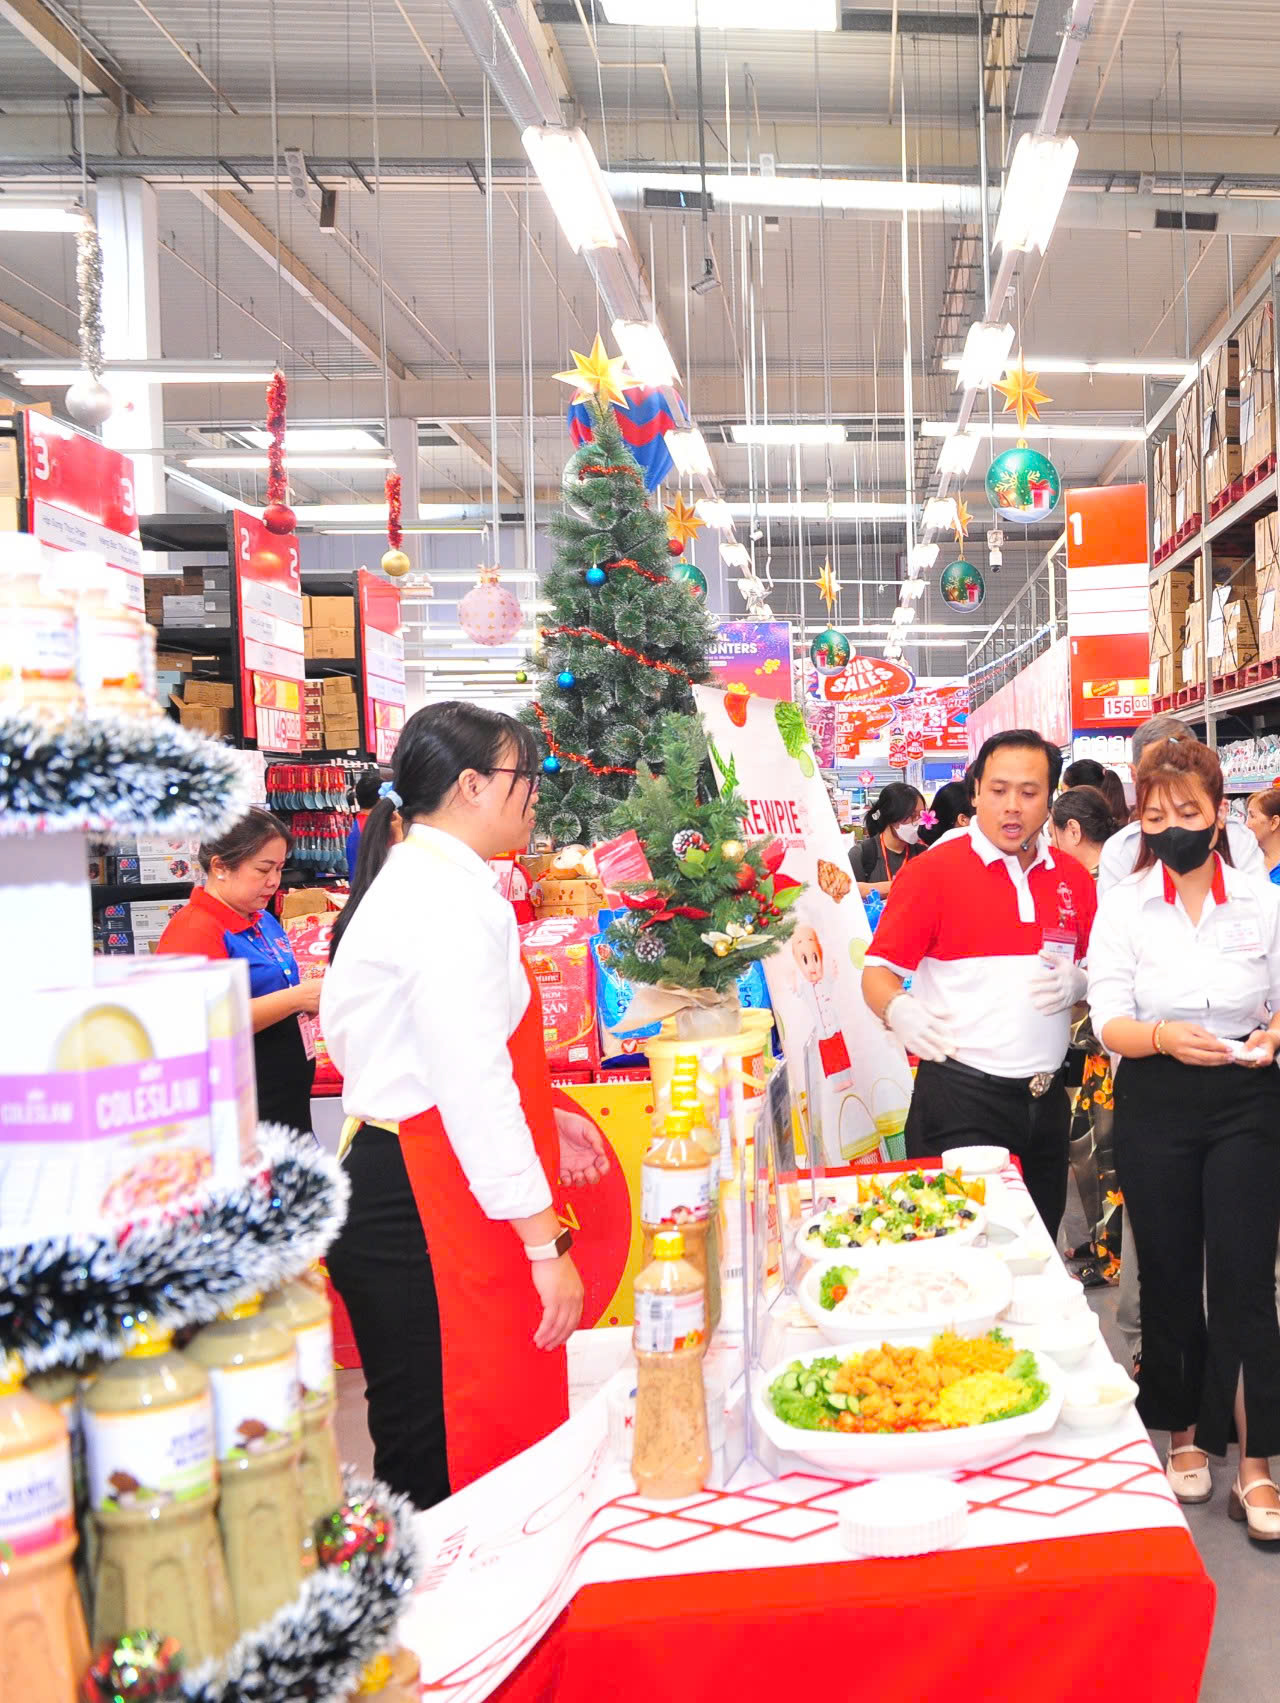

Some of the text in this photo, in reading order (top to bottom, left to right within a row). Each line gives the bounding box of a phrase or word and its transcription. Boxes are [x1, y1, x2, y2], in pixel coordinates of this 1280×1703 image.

[32, 436, 51, 481] 3
[120, 477, 136, 517] 3
[240, 527, 251, 561] 2
[1068, 511, 1083, 546] 1
[289, 548, 299, 579] 2
[1071, 640, 1079, 656] 1
[830, 667, 894, 693] SALES
[1106, 699, 1132, 715] 156
[741, 799, 802, 835] KEWPIE
